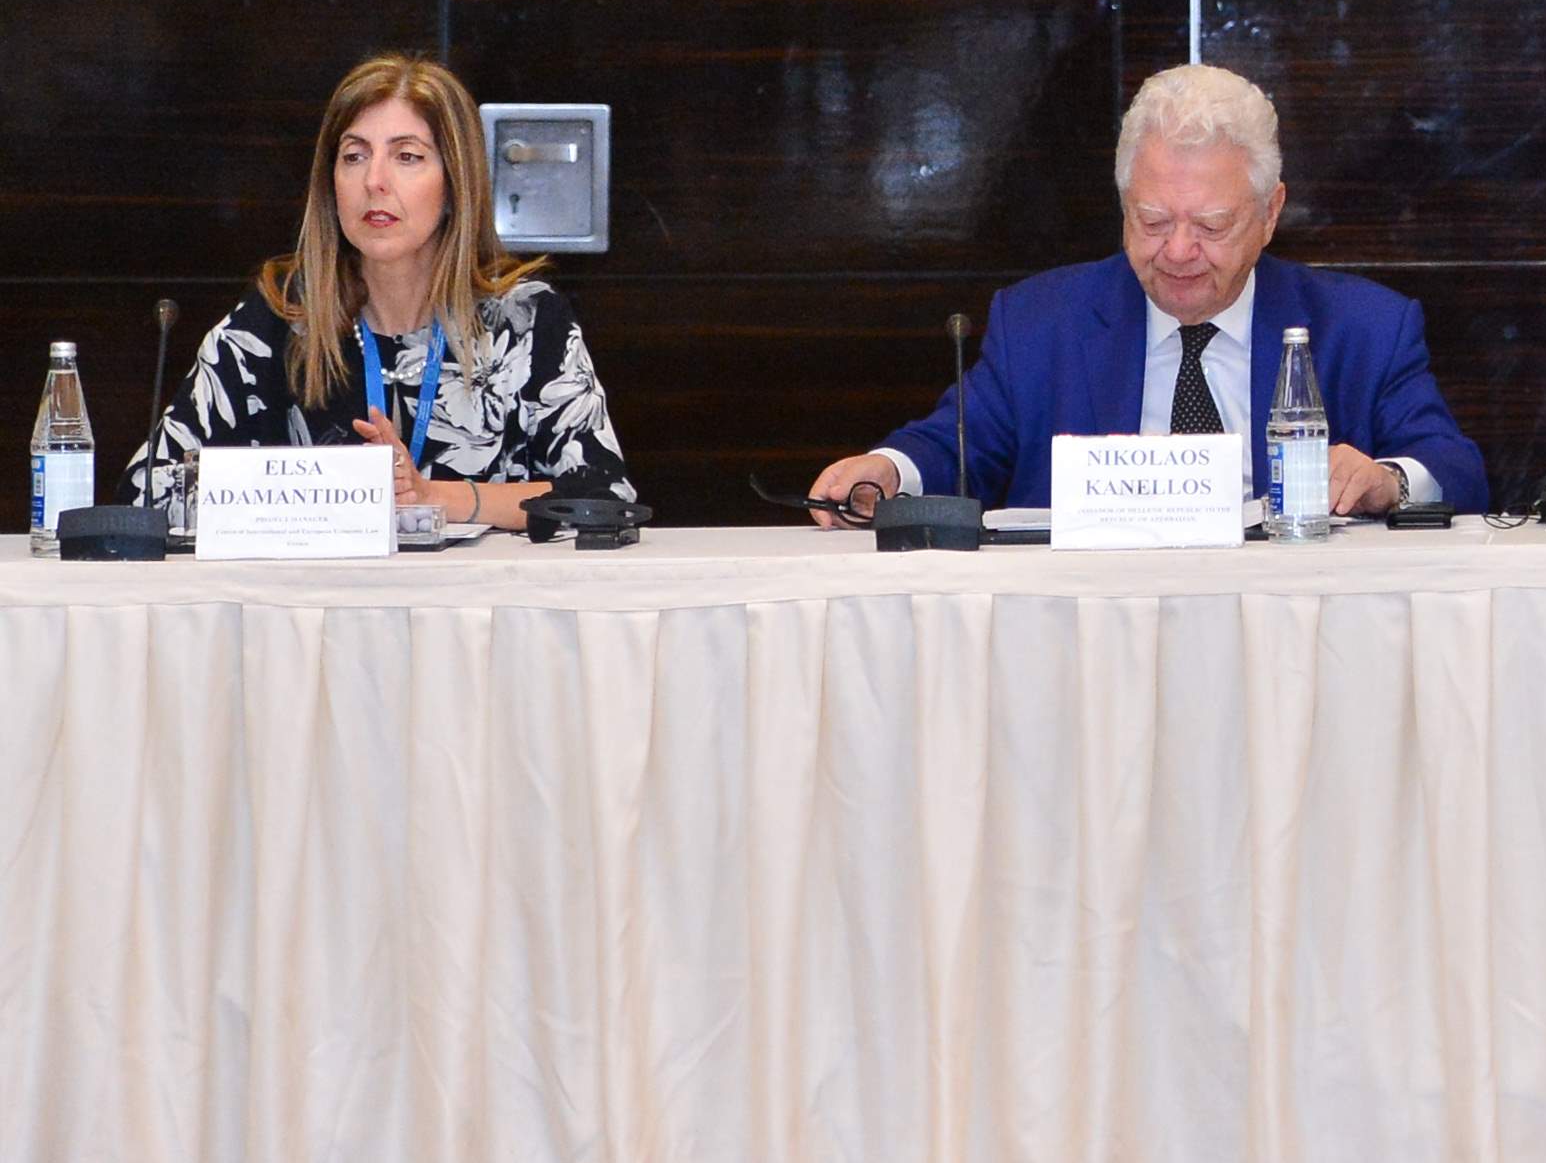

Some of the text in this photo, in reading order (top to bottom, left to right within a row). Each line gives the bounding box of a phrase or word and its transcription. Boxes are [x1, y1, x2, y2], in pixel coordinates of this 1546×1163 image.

[1087, 448, 1211, 467] NIKOLAOS
[265, 459, 324, 476] ELSA
[1085, 478, 1212, 496] KANELLOS
[202, 487, 385, 506] ADAMANTIDOU
